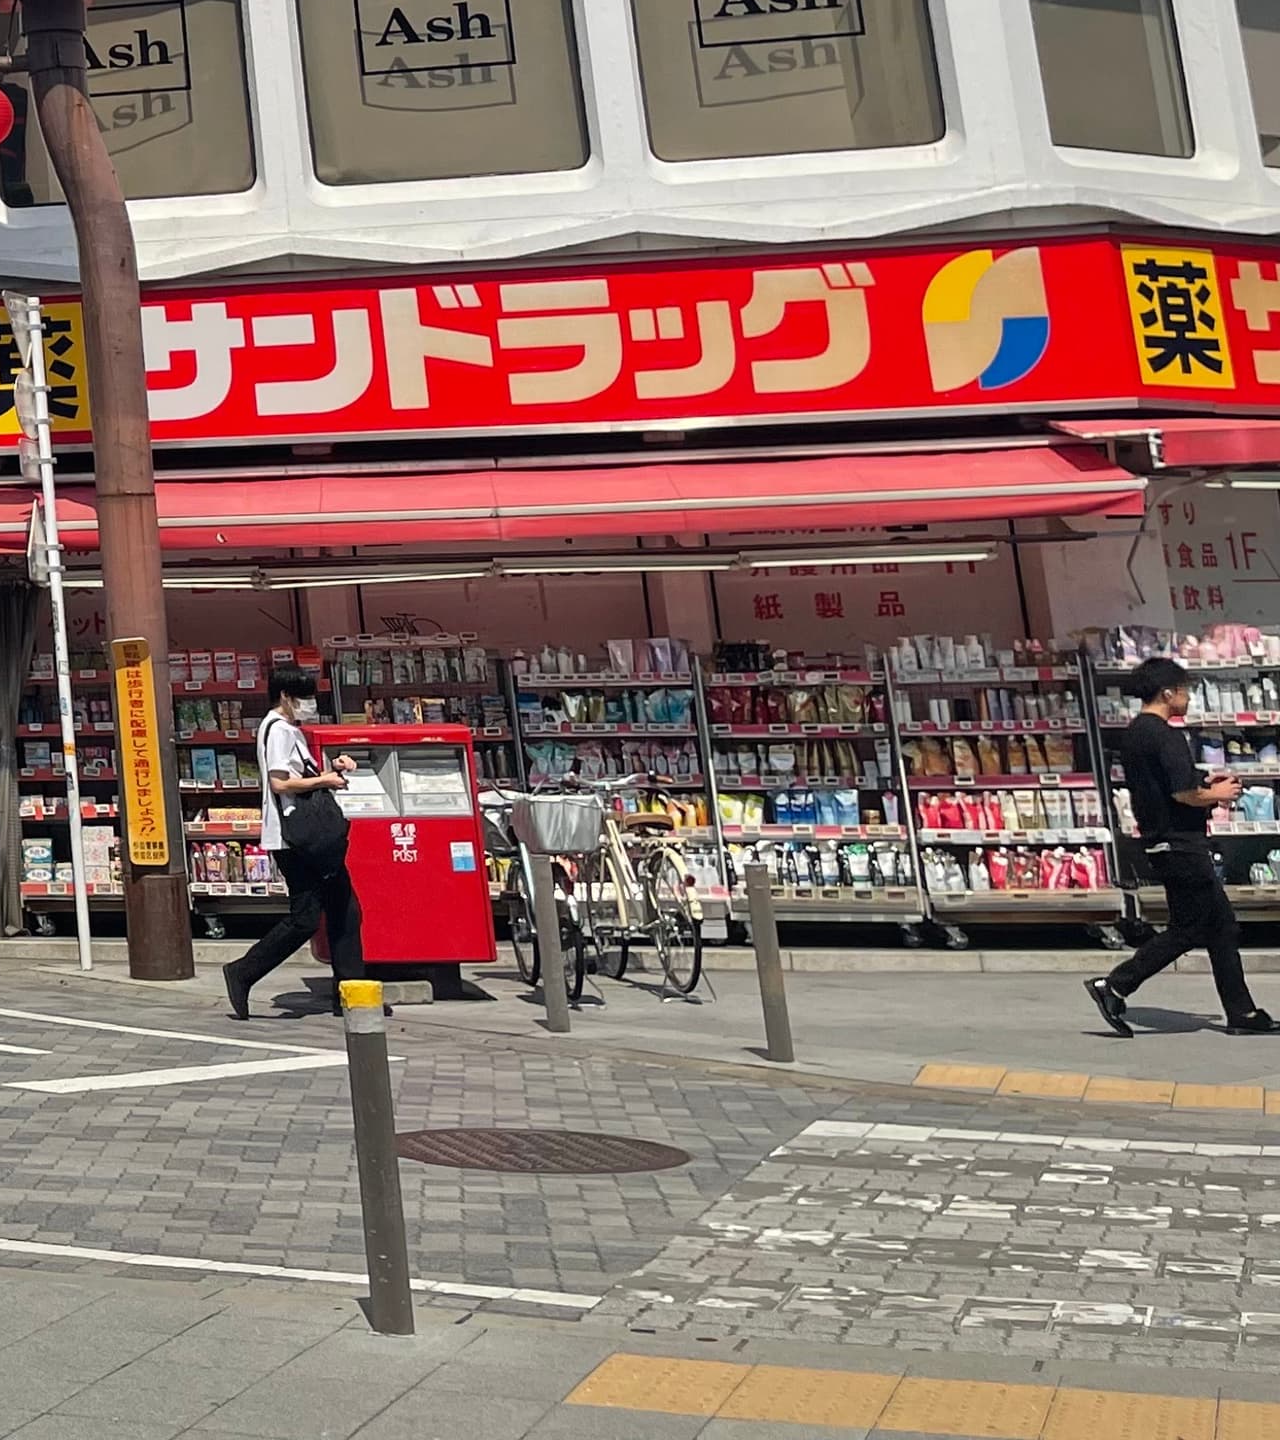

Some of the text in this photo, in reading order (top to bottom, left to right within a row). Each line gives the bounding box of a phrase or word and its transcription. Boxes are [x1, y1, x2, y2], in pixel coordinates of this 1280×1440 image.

[375, 1, 496, 49] Ash
[1132, 257, 1224, 376] 薬
[141, 262, 876, 423] サンドラッグ
[1226, 530, 1258, 570] 1F
[753, 591, 906, 621] 紙製品
[392, 849, 418, 863] POST
